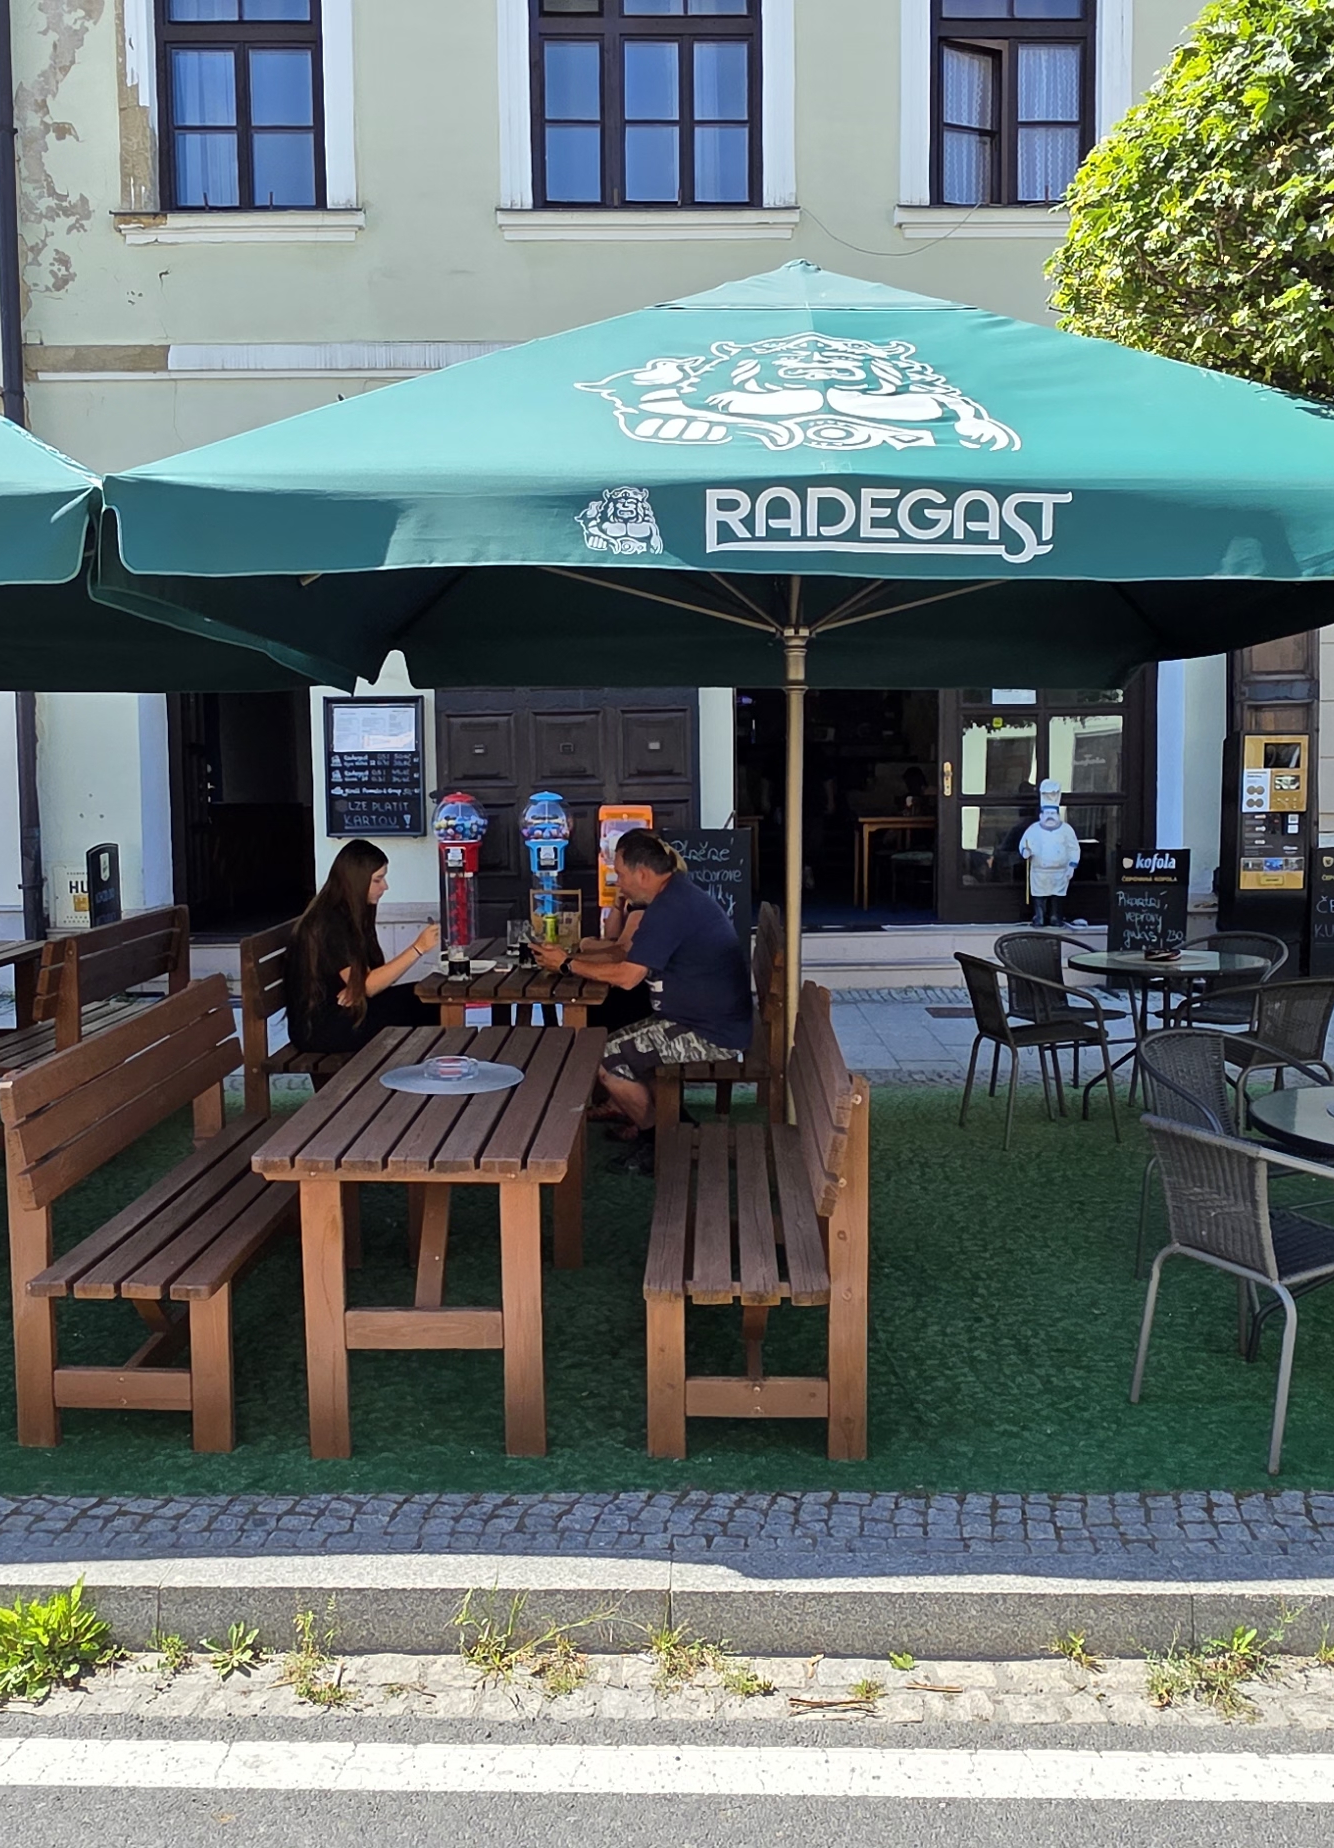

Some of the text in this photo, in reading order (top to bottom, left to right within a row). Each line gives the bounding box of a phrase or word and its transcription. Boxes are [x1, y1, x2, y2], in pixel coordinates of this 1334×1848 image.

[705, 486, 1073, 564] RADEGAST
[1135, 853, 1176, 873] kofola
[69, 881, 89, 893] HU
